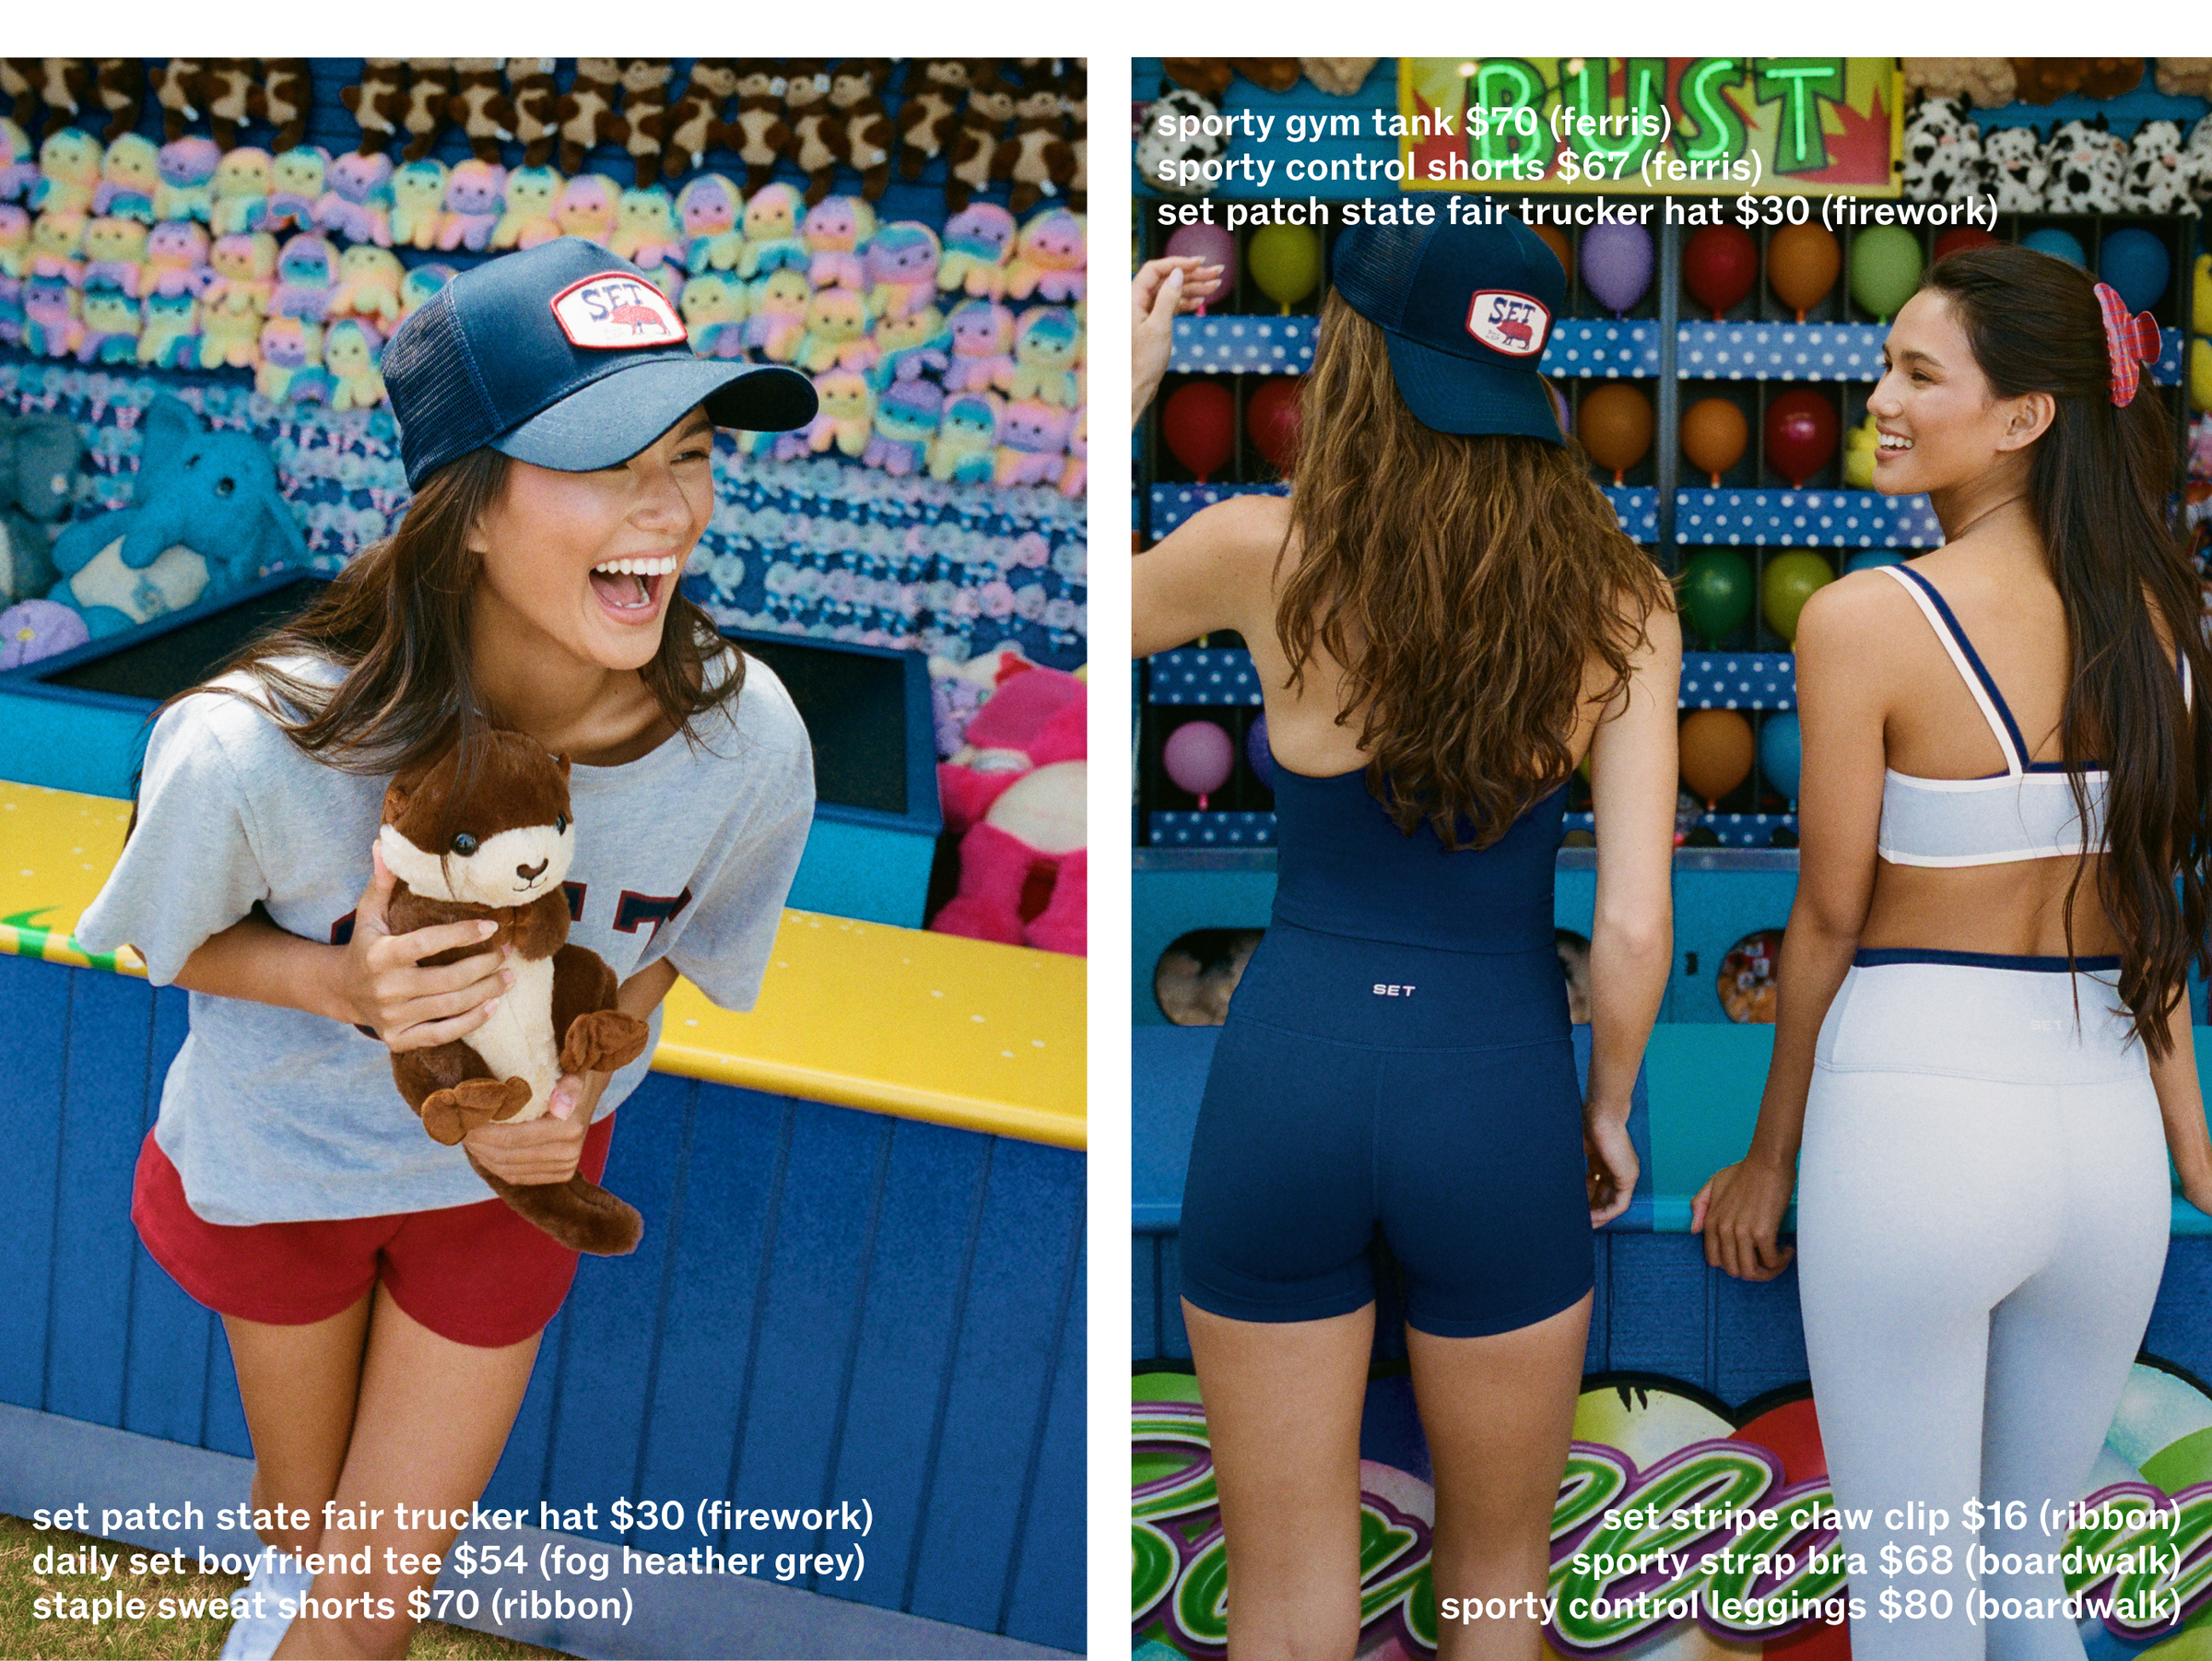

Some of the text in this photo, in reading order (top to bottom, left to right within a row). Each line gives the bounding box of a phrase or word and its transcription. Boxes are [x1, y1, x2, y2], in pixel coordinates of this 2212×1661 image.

[1467, 57, 1844, 175] BUST
[581, 283, 644, 323] SET
[1488, 296, 1536, 324] SET
[1372, 984, 1417, 997] SET
[2030, 1019, 2064, 1031] SET
